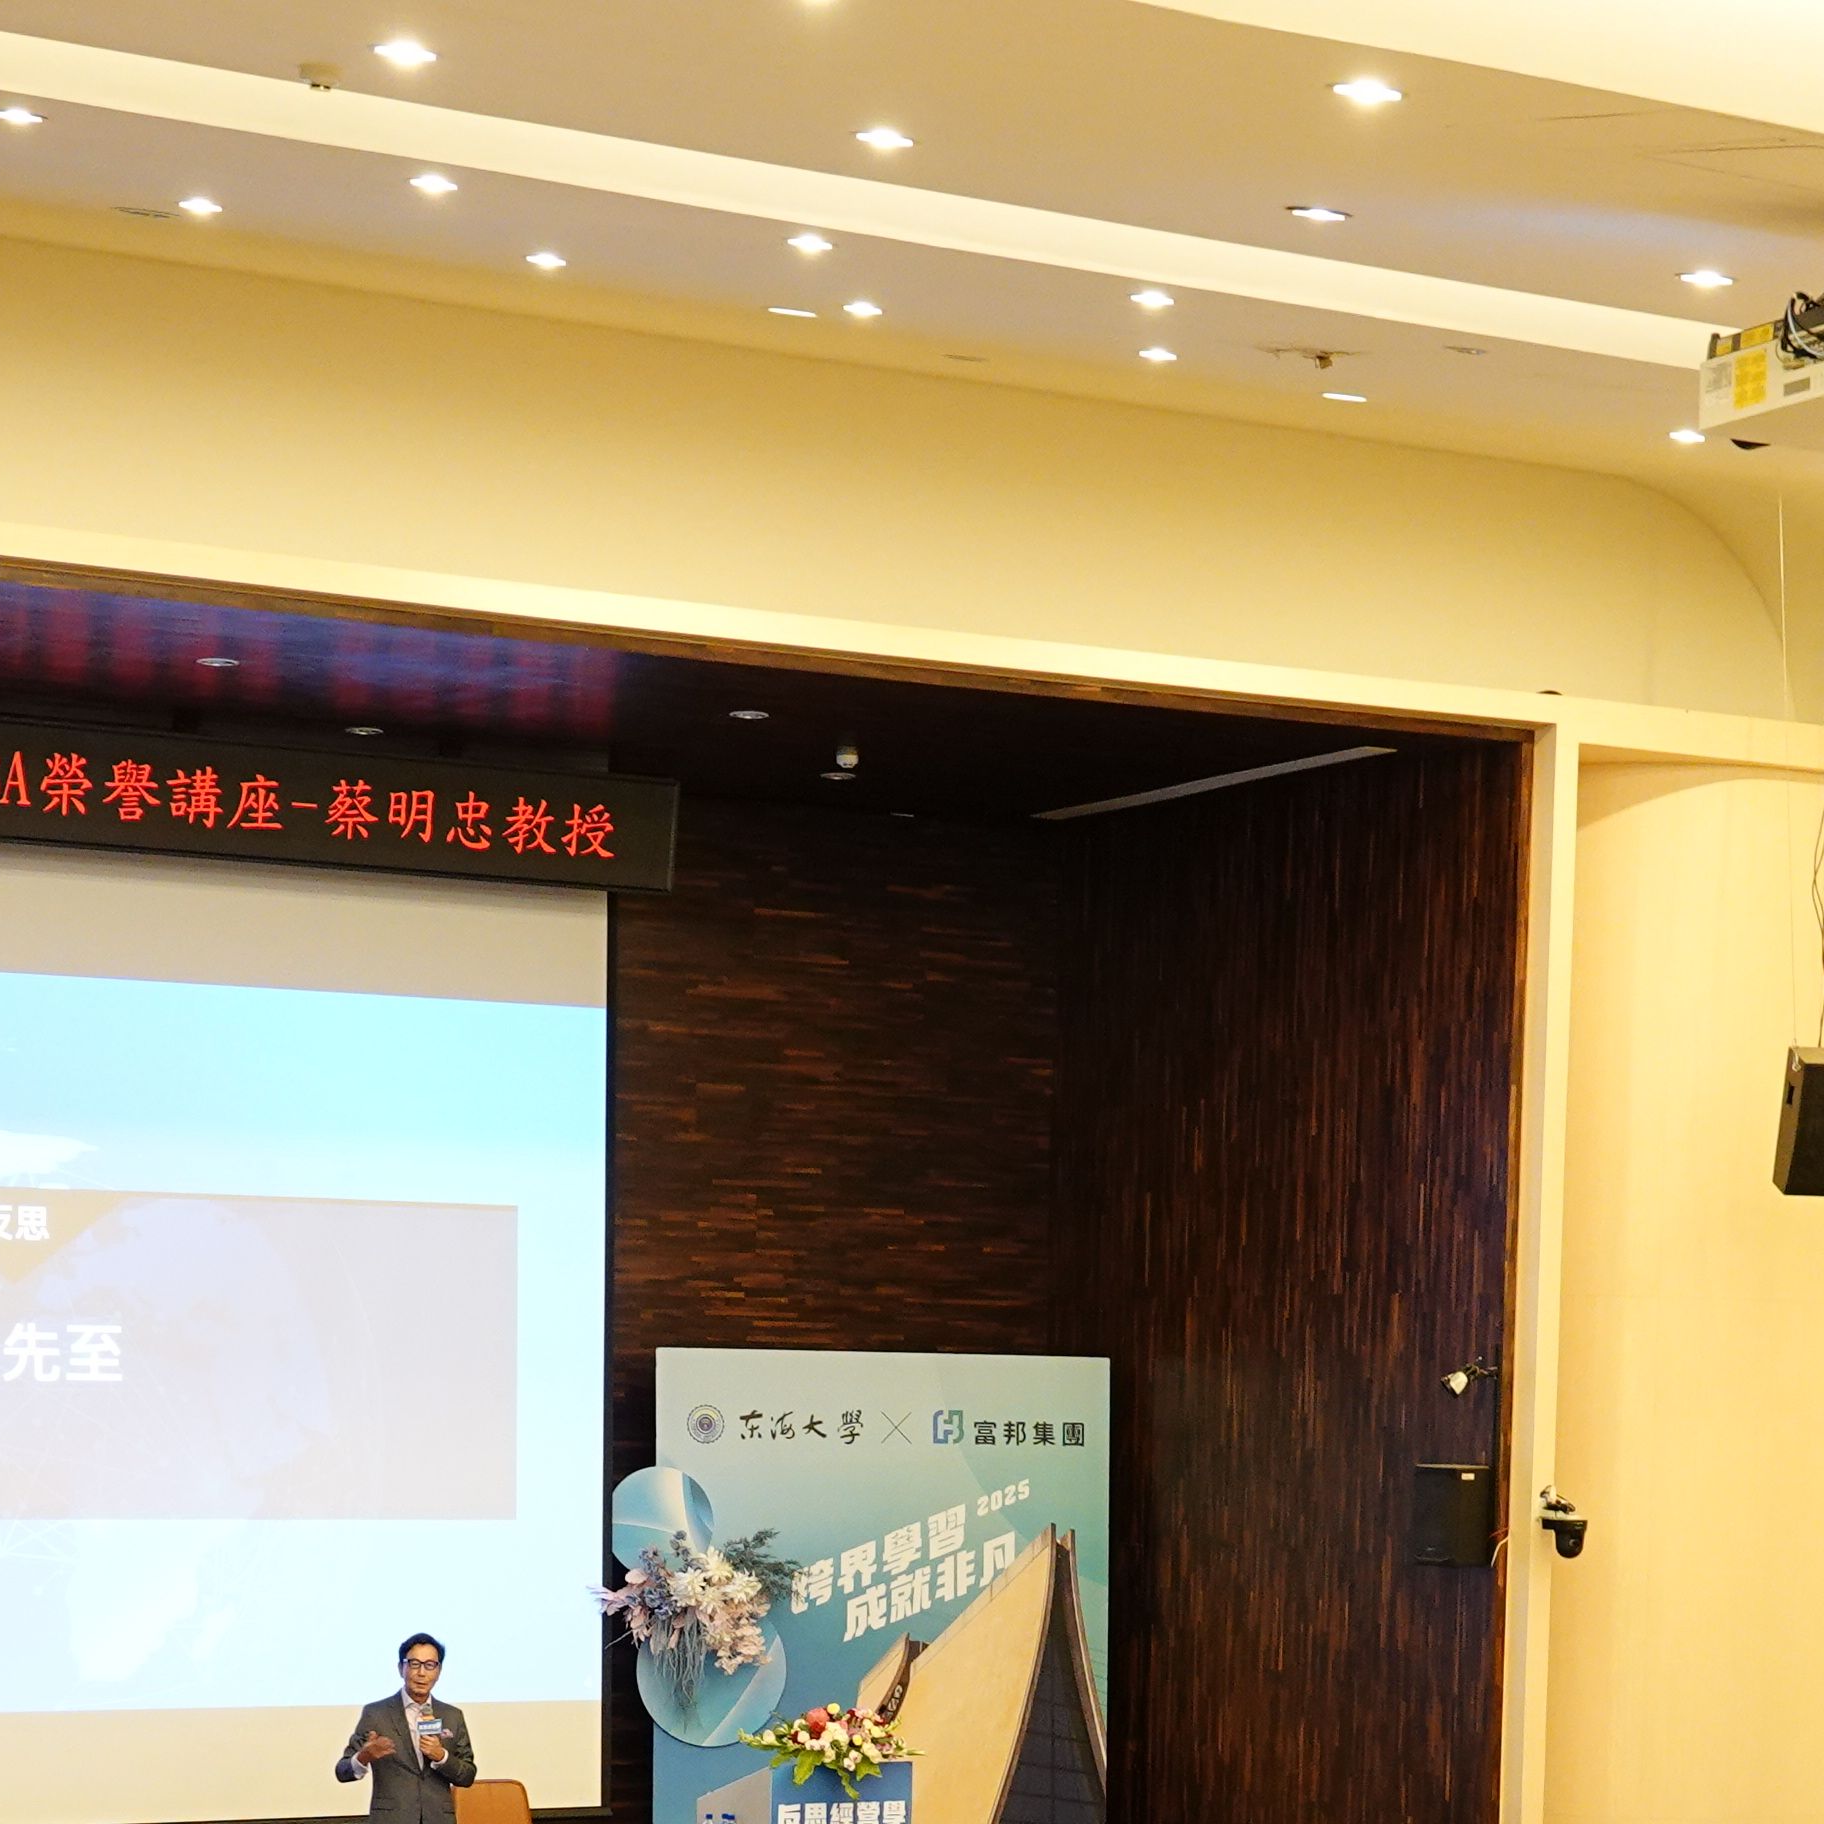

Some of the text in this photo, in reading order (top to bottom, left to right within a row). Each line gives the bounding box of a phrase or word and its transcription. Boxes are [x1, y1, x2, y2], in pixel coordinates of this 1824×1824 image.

[973, 1420, 1086, 1447] 富邦集團
[791, 1478, 1031, 1614] 跨界學習 2025
[843, 1530, 1017, 1643] 成就非凡
